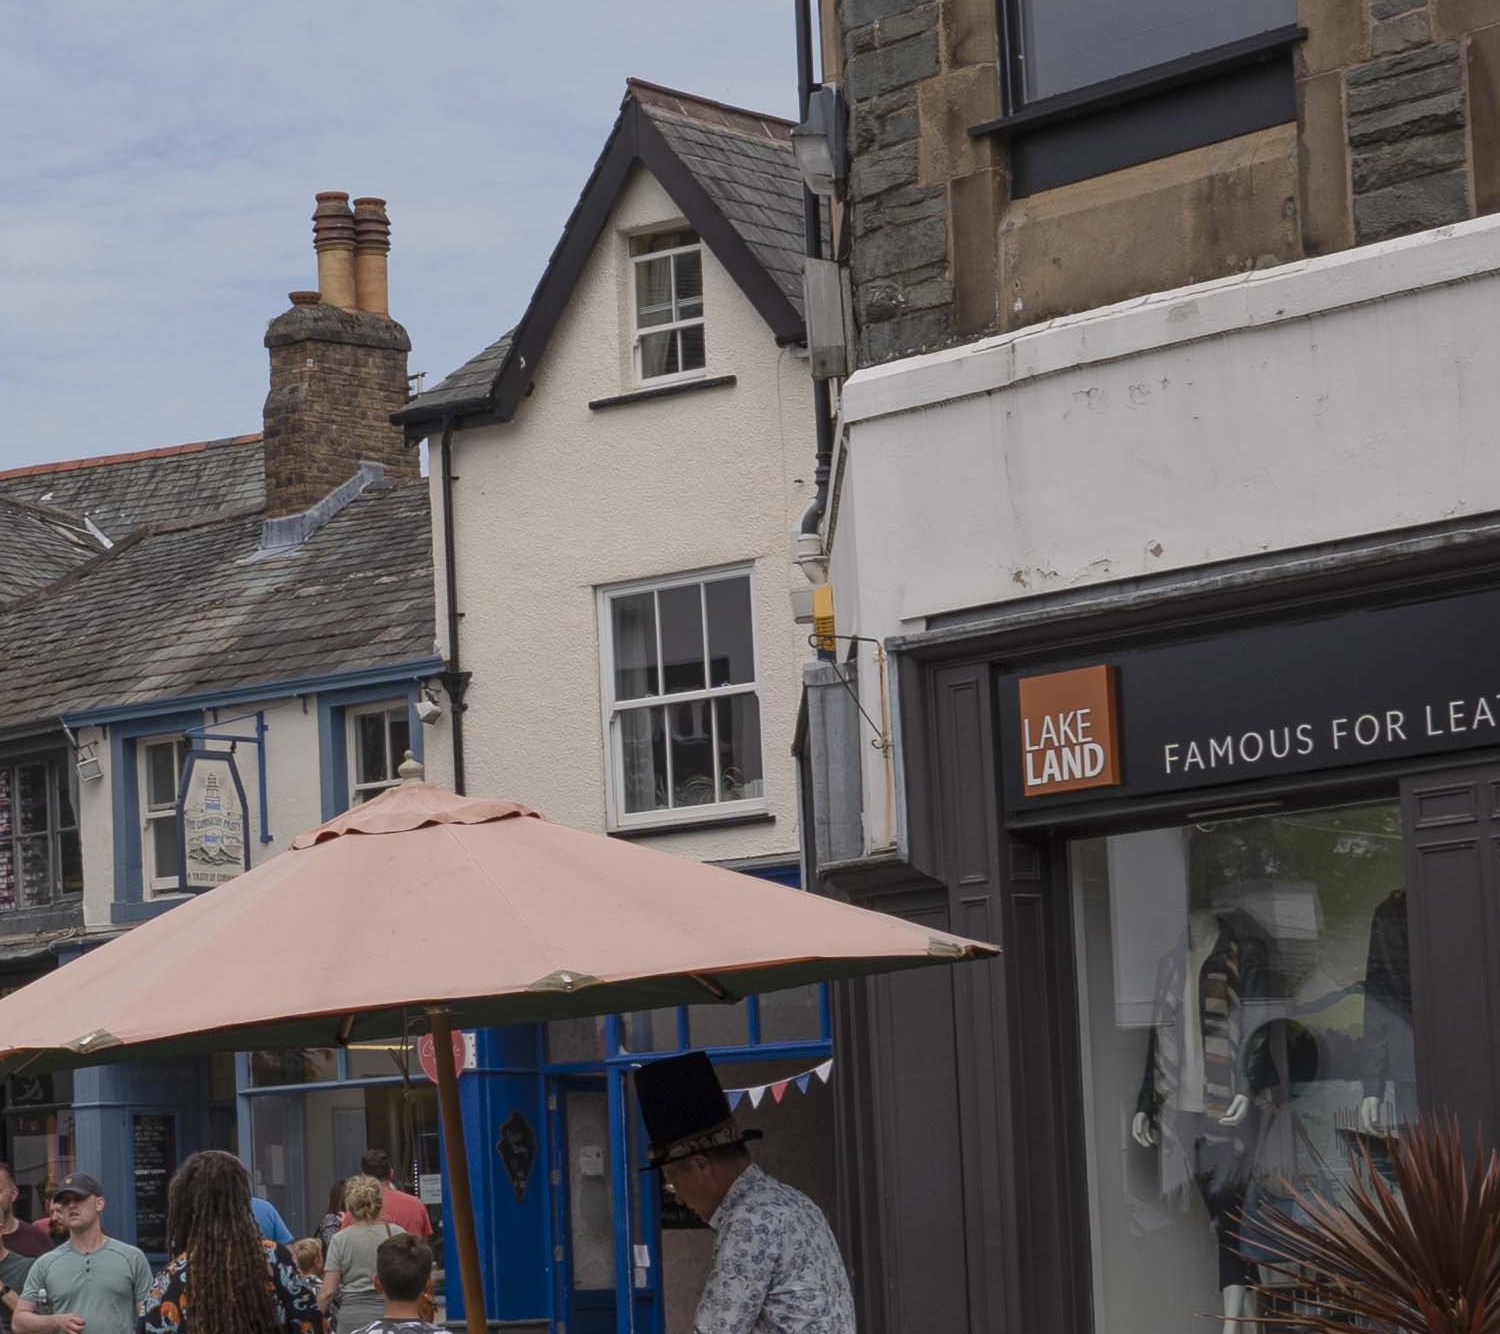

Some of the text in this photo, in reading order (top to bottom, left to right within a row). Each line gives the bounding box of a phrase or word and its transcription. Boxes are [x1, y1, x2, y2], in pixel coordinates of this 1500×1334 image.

[1023, 707, 1092, 752] LAKE
[1164, 722, 1316, 774] FAMOUS
[1332, 711, 1407, 751] FOR
[1025, 741, 1106, 787] LAND
